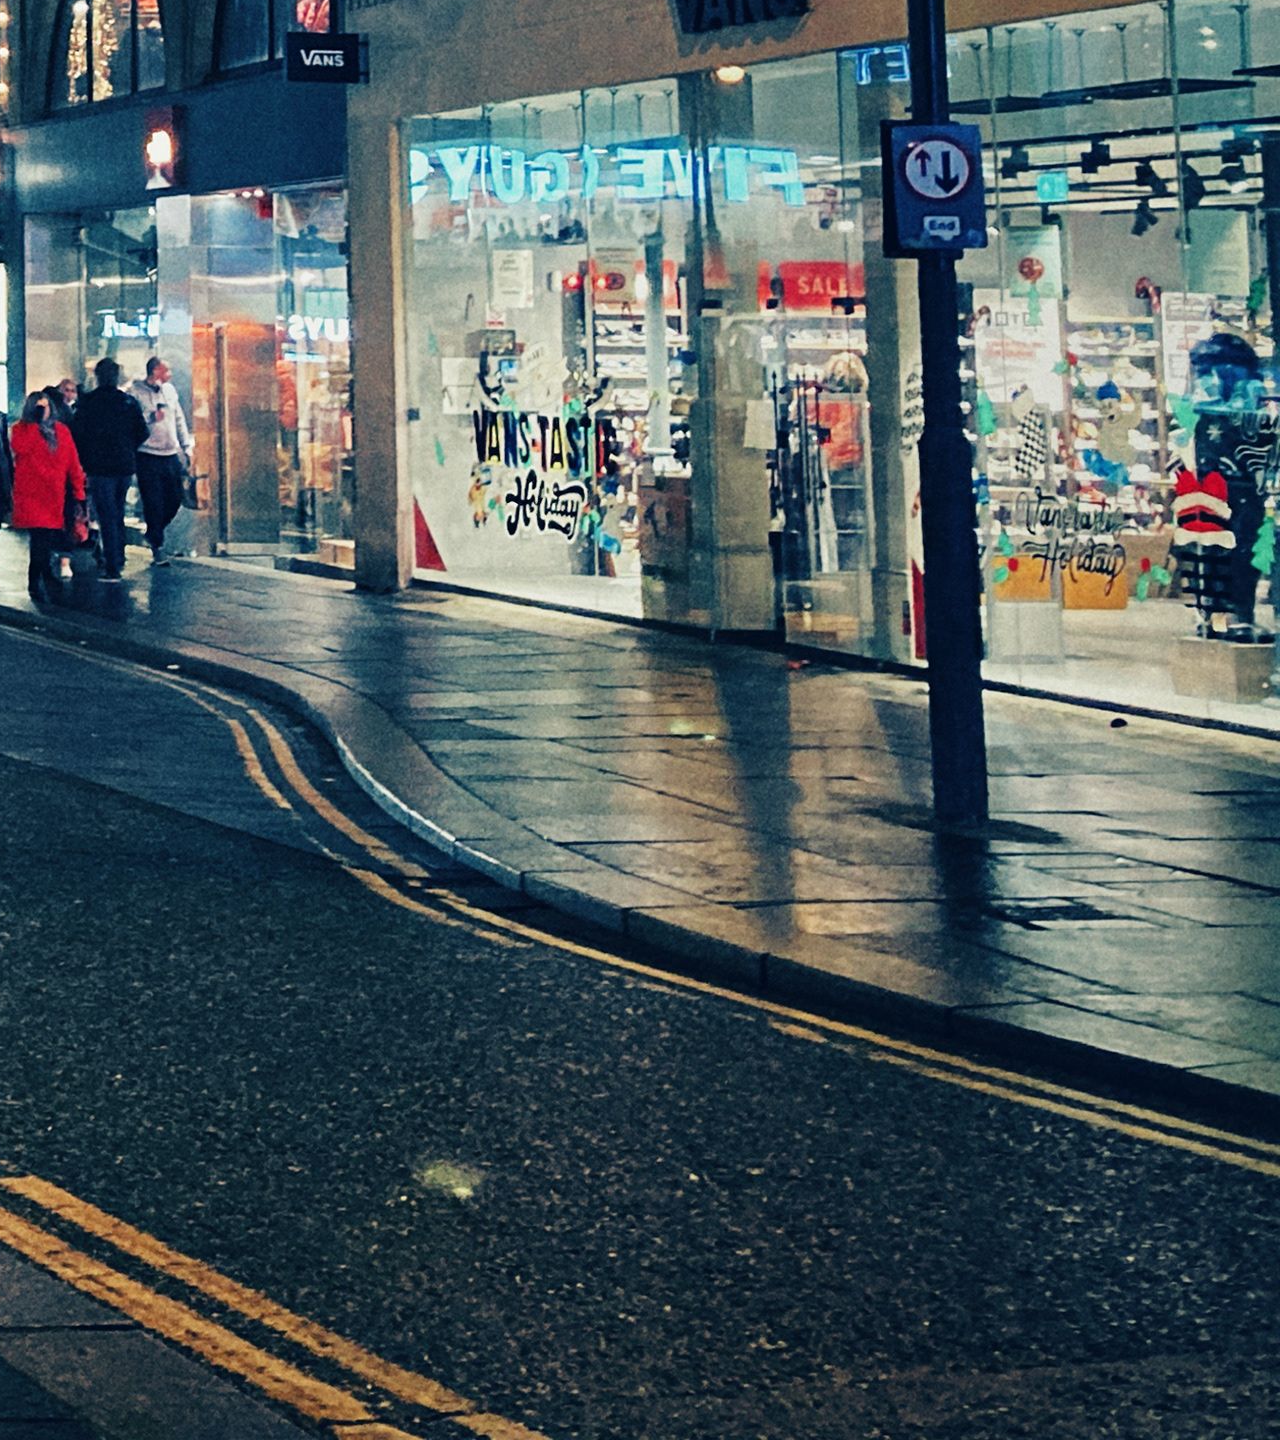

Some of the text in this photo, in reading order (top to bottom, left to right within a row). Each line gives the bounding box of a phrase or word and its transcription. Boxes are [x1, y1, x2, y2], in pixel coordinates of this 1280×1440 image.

[300, 49, 345, 67] VANS
[929, 220, 956, 231] End
[505, 469, 586, 540] Holiday
[1022, 538, 1127, 597] Holiday
